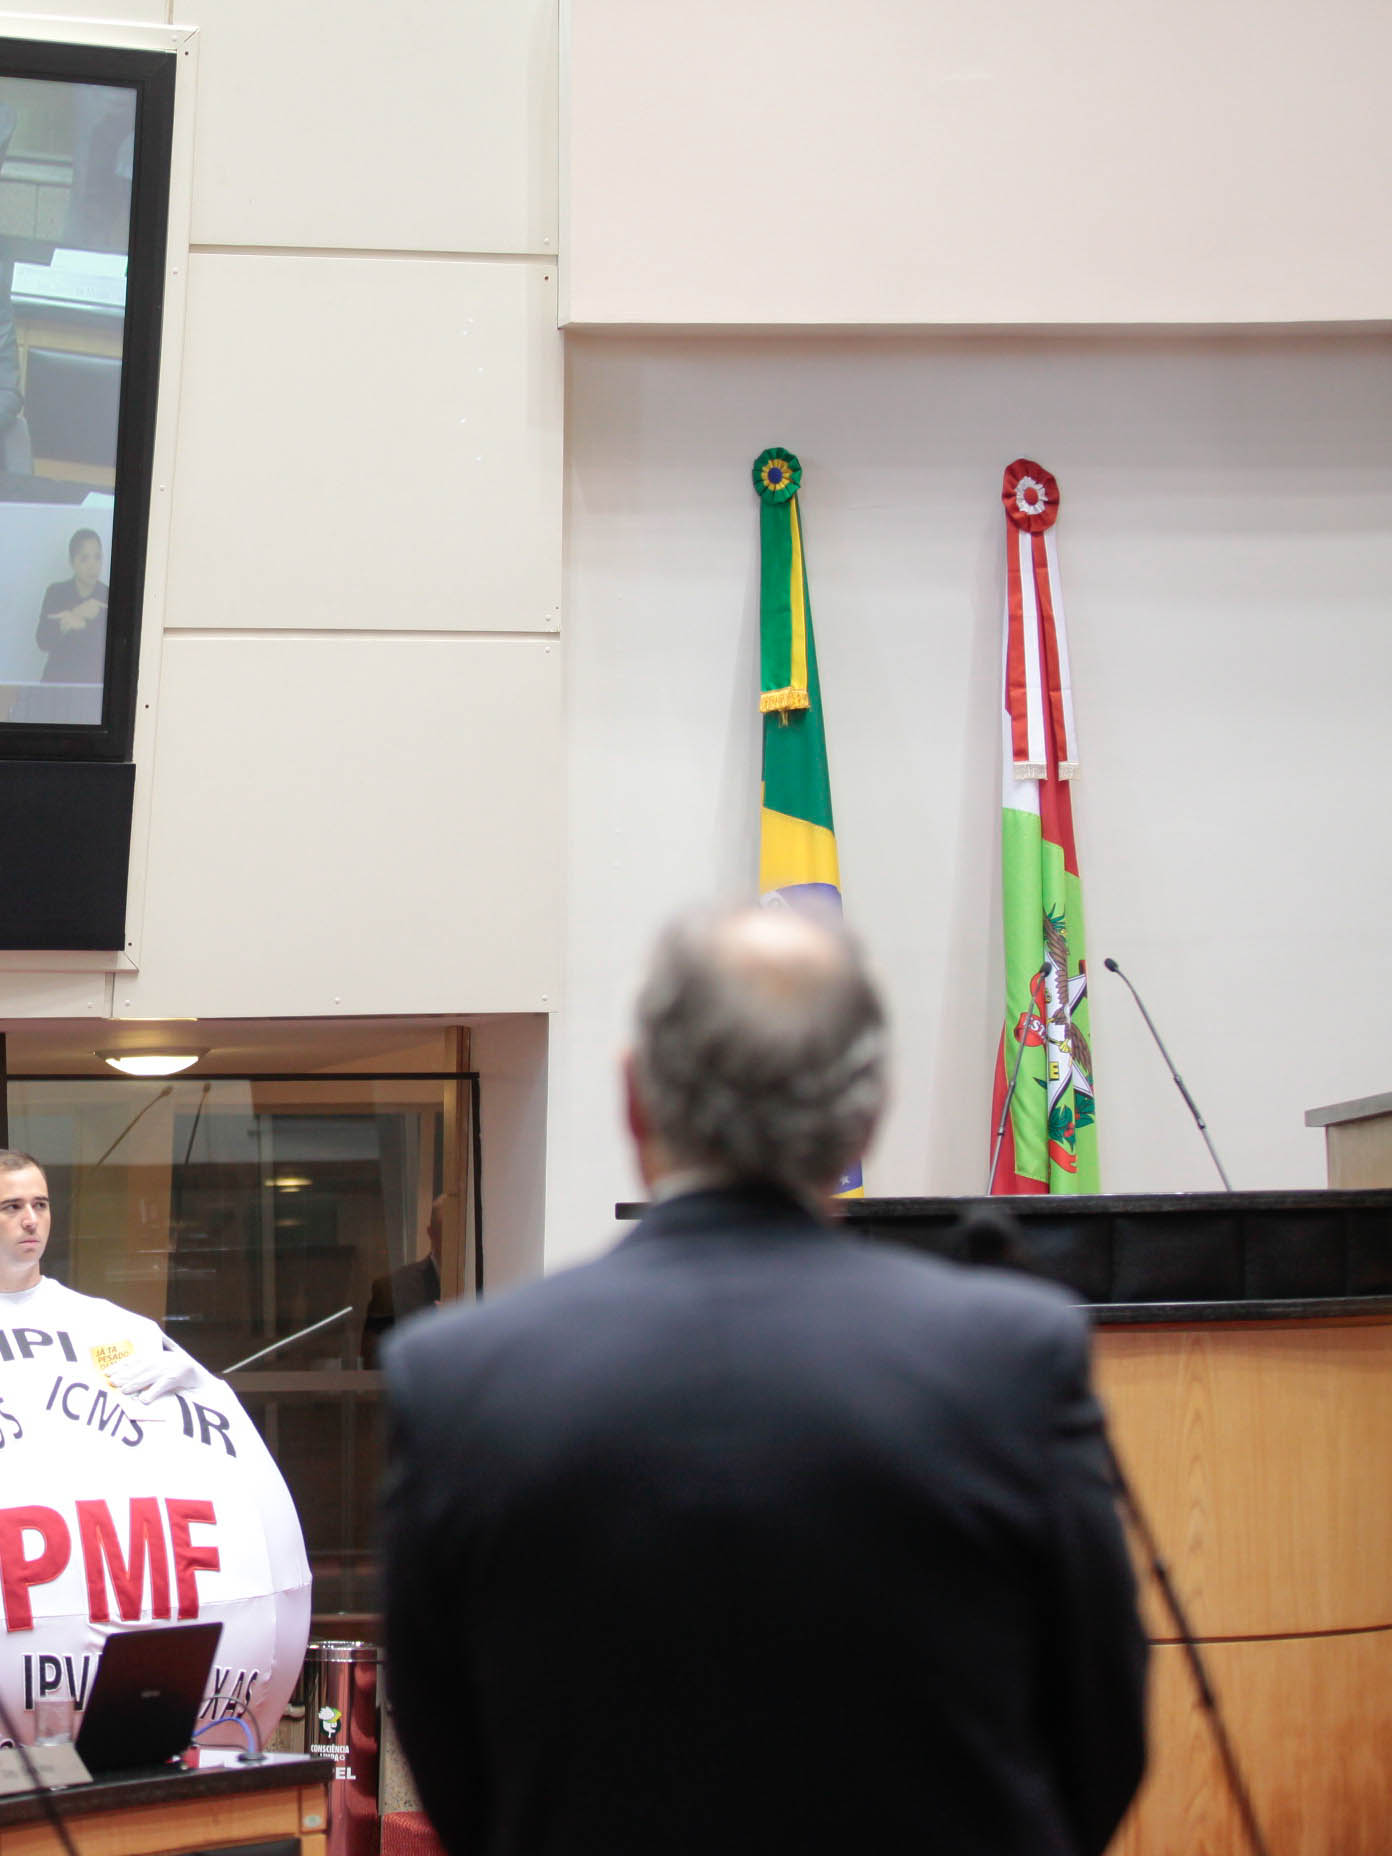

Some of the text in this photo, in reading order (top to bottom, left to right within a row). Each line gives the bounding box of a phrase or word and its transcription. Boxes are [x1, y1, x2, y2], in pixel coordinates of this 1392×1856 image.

[46, 1376, 144, 1447] ICMS
[175, 1393, 237, 1458] IR
[23, 1653, 101, 1712] IPV
[310, 1743, 350, 1754] CONSCIÊNCIA
